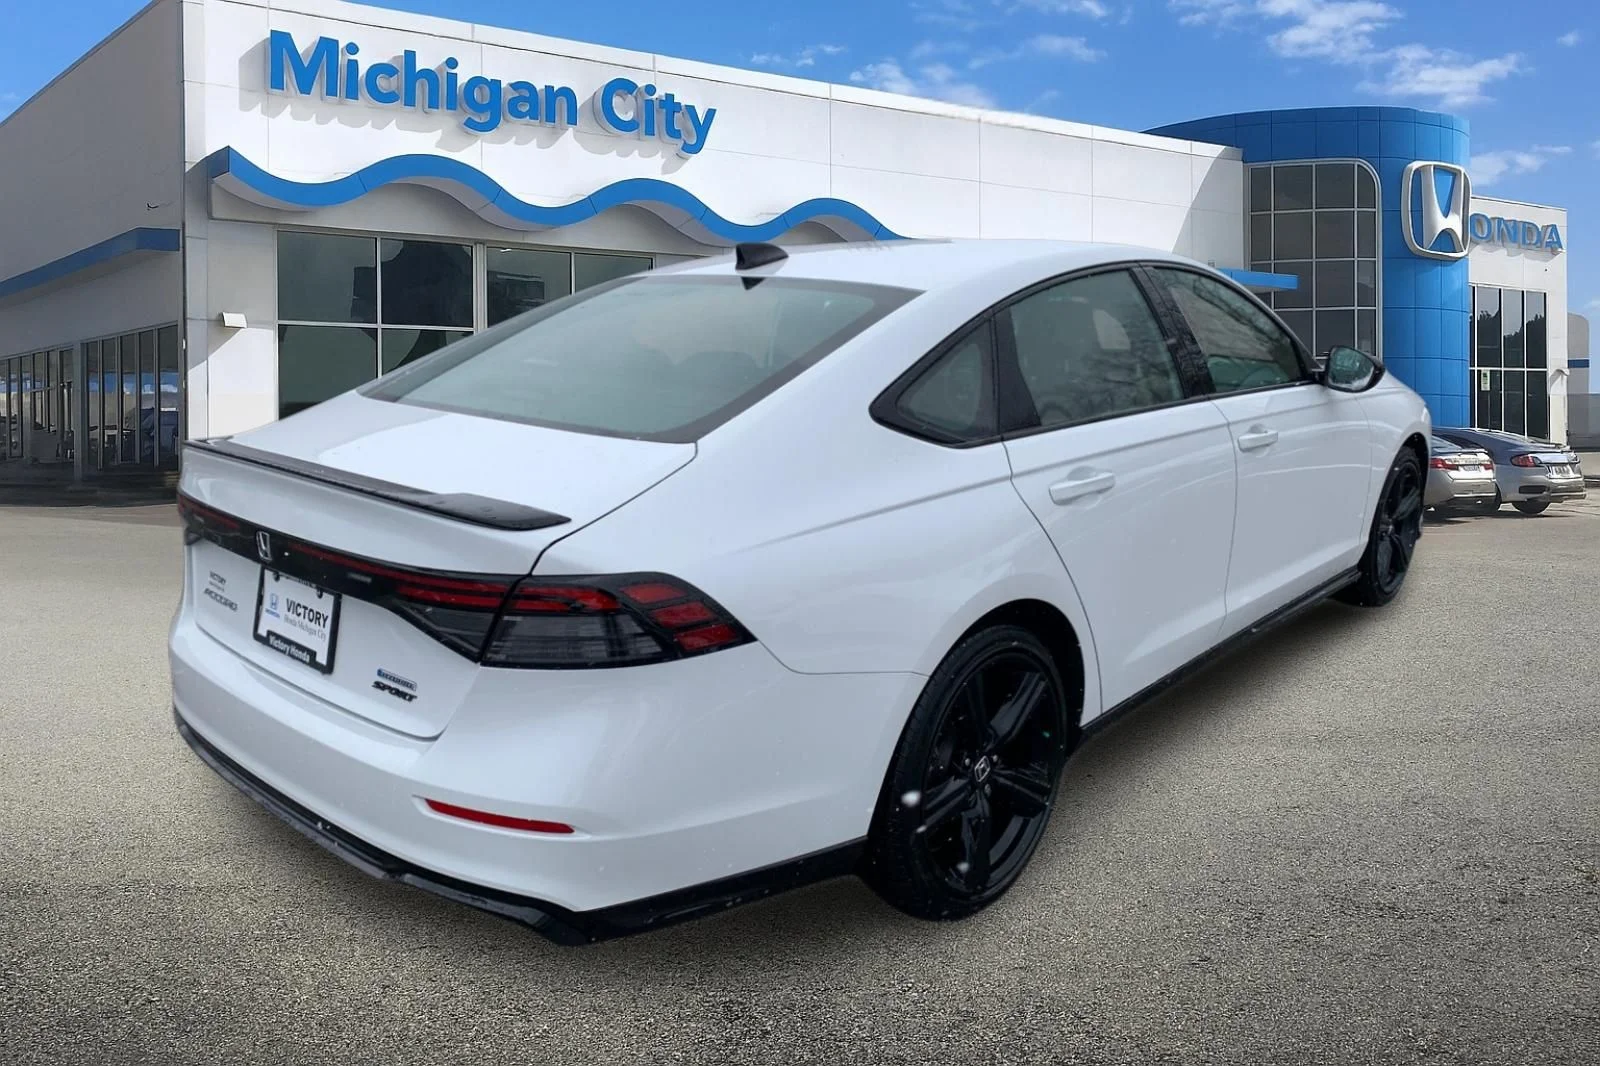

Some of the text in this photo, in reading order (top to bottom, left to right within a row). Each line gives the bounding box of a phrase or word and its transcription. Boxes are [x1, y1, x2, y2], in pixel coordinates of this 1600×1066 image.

[269, 29, 717, 155] Michigan City
[1469, 212, 1564, 250] ONDA
[285, 597, 329, 628] VICTORY
[268, 634, 310, 662] Victory Honda
[371, 680, 418, 702] SPORT
